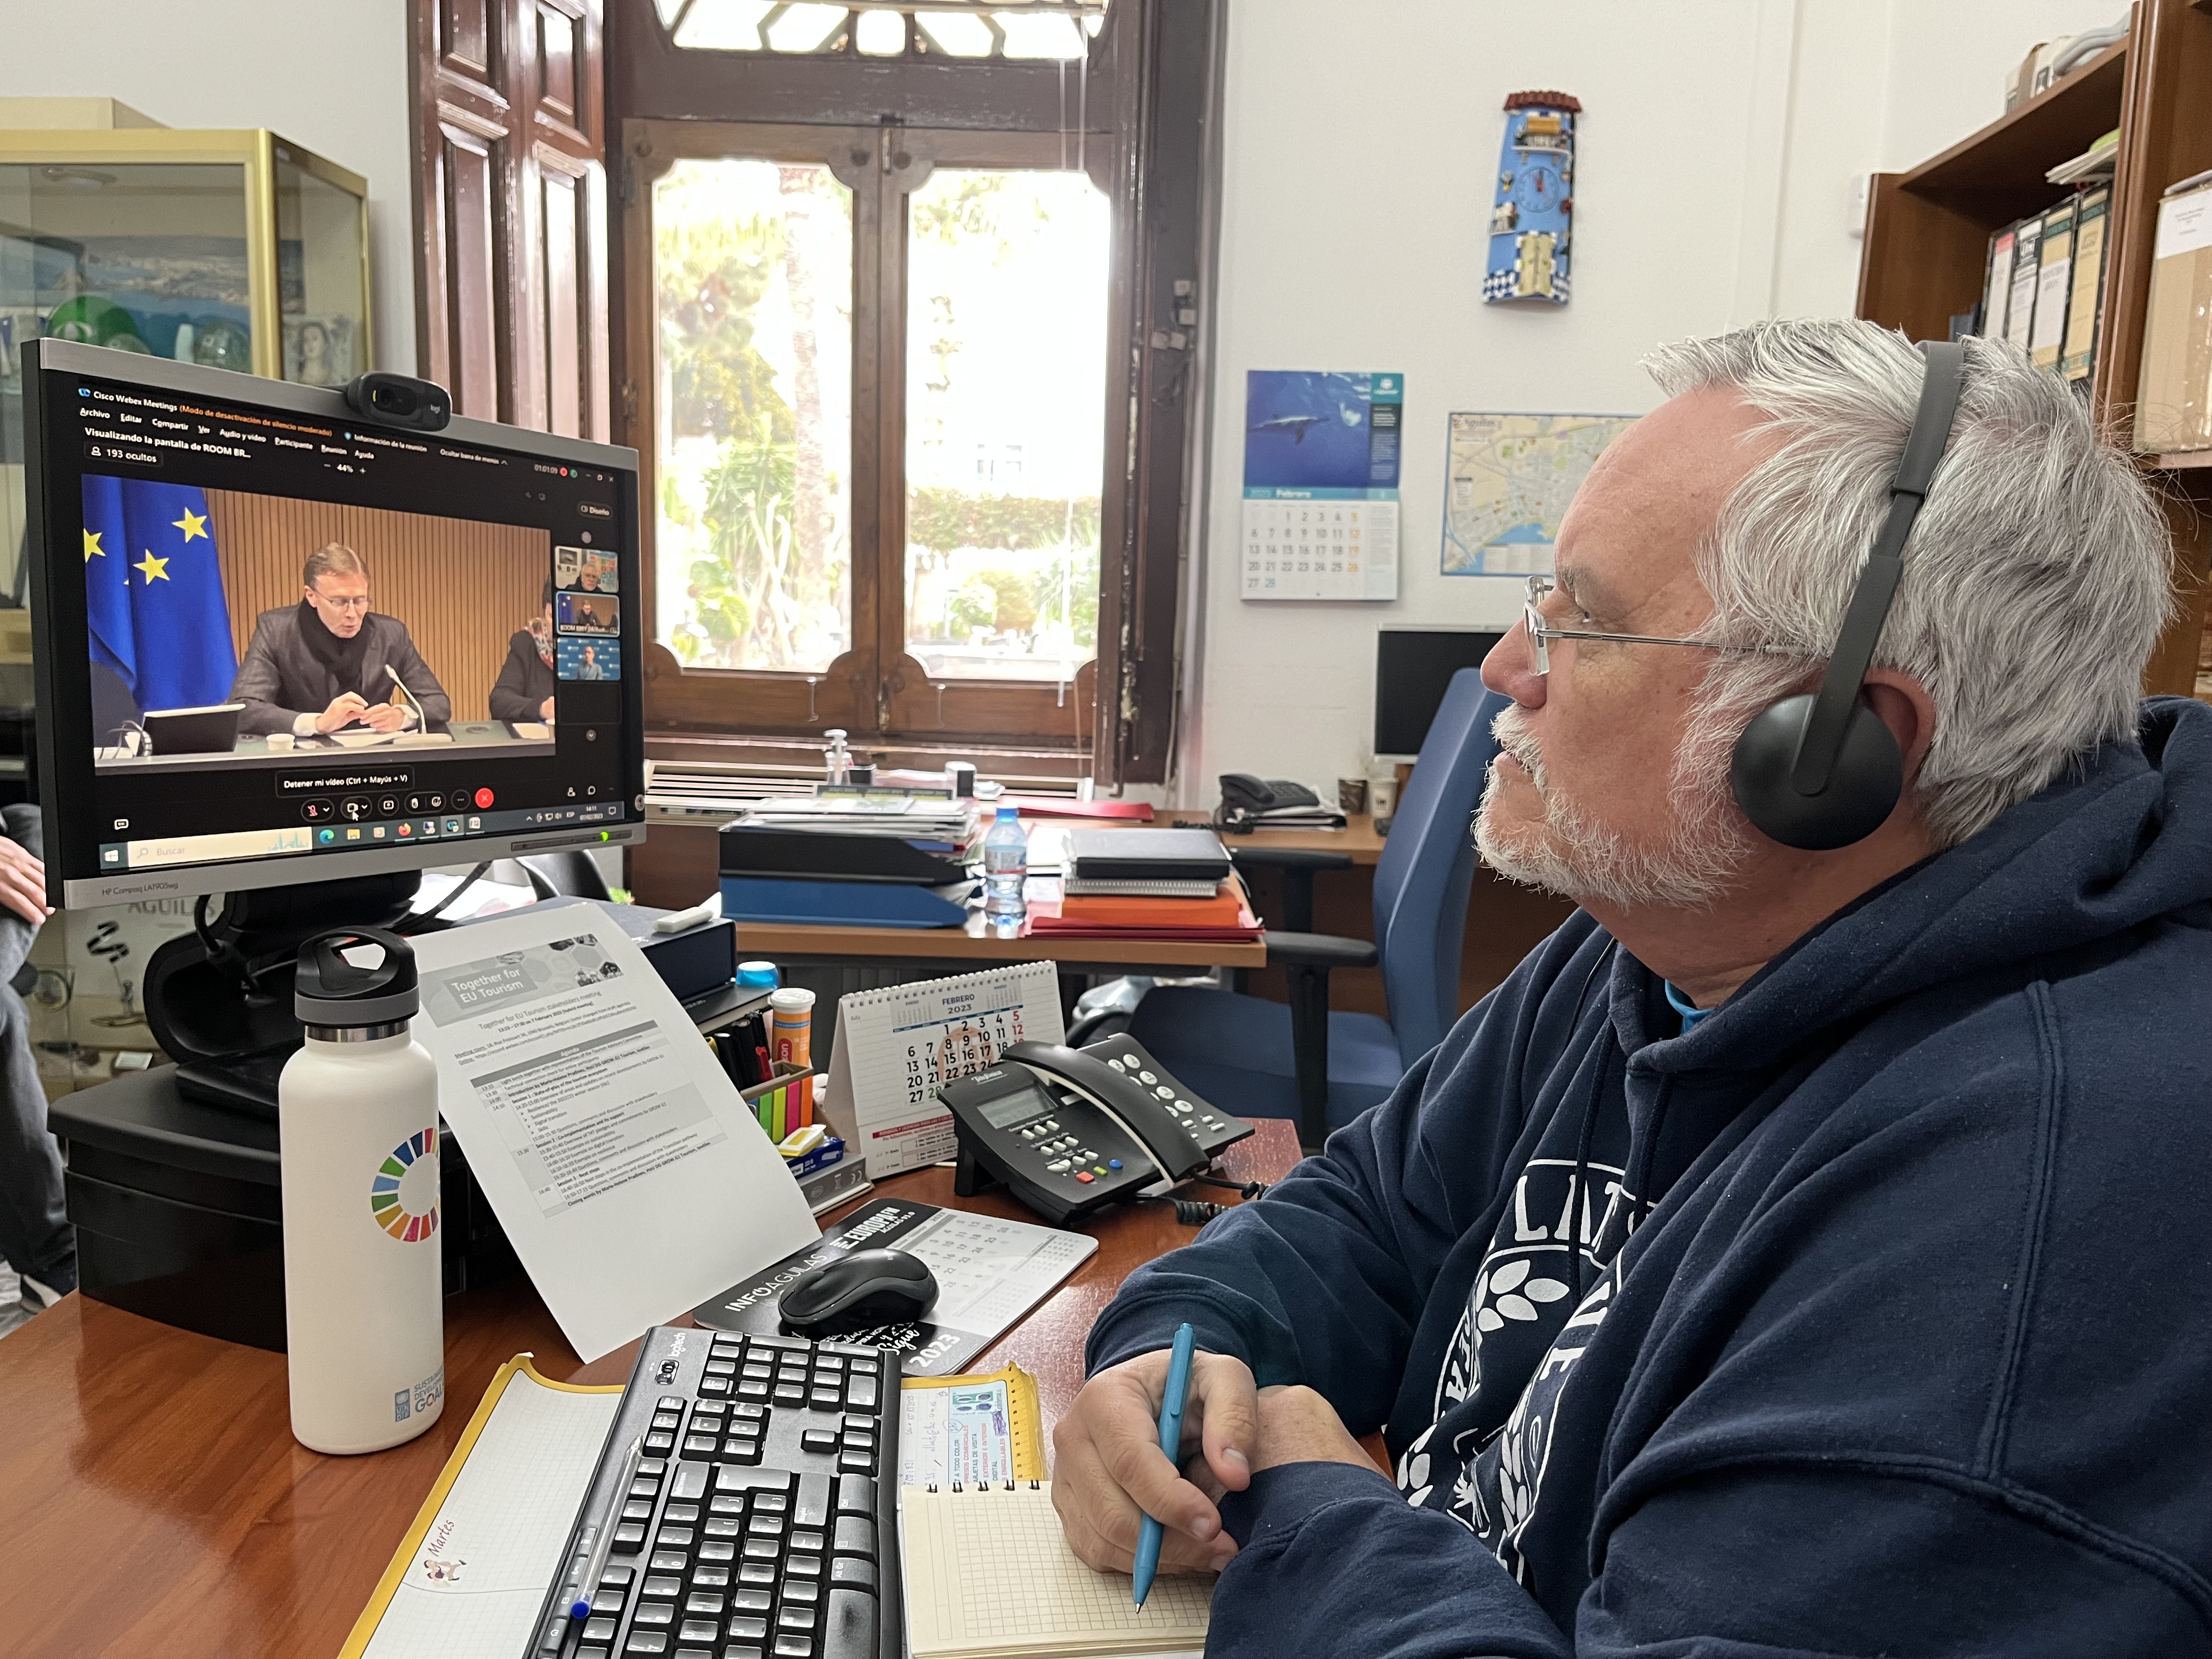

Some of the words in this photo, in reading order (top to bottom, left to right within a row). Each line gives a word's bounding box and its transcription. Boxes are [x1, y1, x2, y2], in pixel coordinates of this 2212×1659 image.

[94, 391, 114, 401] Cisco
[116, 394, 142, 405] Webex
[143, 399, 177, 412] Meetings
[80, 407, 110, 419] Archivo
[120, 413, 142, 424] Editar
[152, 419, 189, 431] Compartir
[198, 425, 210, 434] Ver
[220, 428, 241, 438] Audio
[85, 427, 142, 443] Visualizando
[155, 438, 189, 449] pantalla
[190, 443, 201, 451] de
[203, 444, 232, 455] ROOM
[106, 448, 123, 458] 193
[126, 453, 157, 463] ocultos
[1276, 488, 1312, 498] Febrero
[1301, 511, 1308, 521] 2
[1251, 528, 1258, 537] 6
[284, 780, 313, 788] Detener
[315, 778, 324, 787] mi
[346, 777, 361, 786] (Ctrl
[370, 775, 392, 785] Mayús
[400, 774, 408, 782] V)
[157, 847, 185, 856] Buscar
[114, 887, 143, 895] Compaq
[452, 973, 502, 992] Together
[504, 969, 521, 979] for
[460, 991, 477, 1003] EU
[478, 981, 524, 998] Tourism
[942, 994, 975, 1005] FEBRERO
[478, 1017, 506, 1031] Together
[523, 1006, 547, 1017] Tourism
[579, 990, 602, 1001] meeting
[948, 1003, 973, 1014] 2023
[944, 1024, 949, 1035] 1
[962, 1021, 968, 1031] 2
[979, 1017, 985, 1028] 3
[996, 1014, 1002, 1024] 4
[1013, 1011, 1020, 1021] 5
[908, 1046, 915, 1057] 6
[927, 1042, 933, 1053] 7
[945, 1039, 952, 1049] 8
[963, 1035, 969, 1046] 9
[978, 1032, 990, 1042] 10
[997, 1028, 1005, 1039] 11
[1012, 1024, 1024, 1036] 12
[559, 1046, 580, 1058] Agenda
[907, 1060, 919, 1073] 13
[926, 1057, 938, 1069] 14
[945, 1053, 956, 1064] 15
[963, 1049, 974, 1060] 16
[980, 1046, 991, 1057] 17
[997, 1042, 1008, 1053] 18
[907, 1075, 922, 1088] 20
[928, 1071, 939, 1084] 21
[945, 1067, 960, 1080] 22
[963, 1063, 977, 1075] 23
[909, 1090, 923, 1103] 27
[668, 1332, 686, 1358] logitech
[877, 1329, 920, 1356] Sigue
[909, 1334, 961, 1368] 2023
[427, 1519, 455, 1557] Martes
